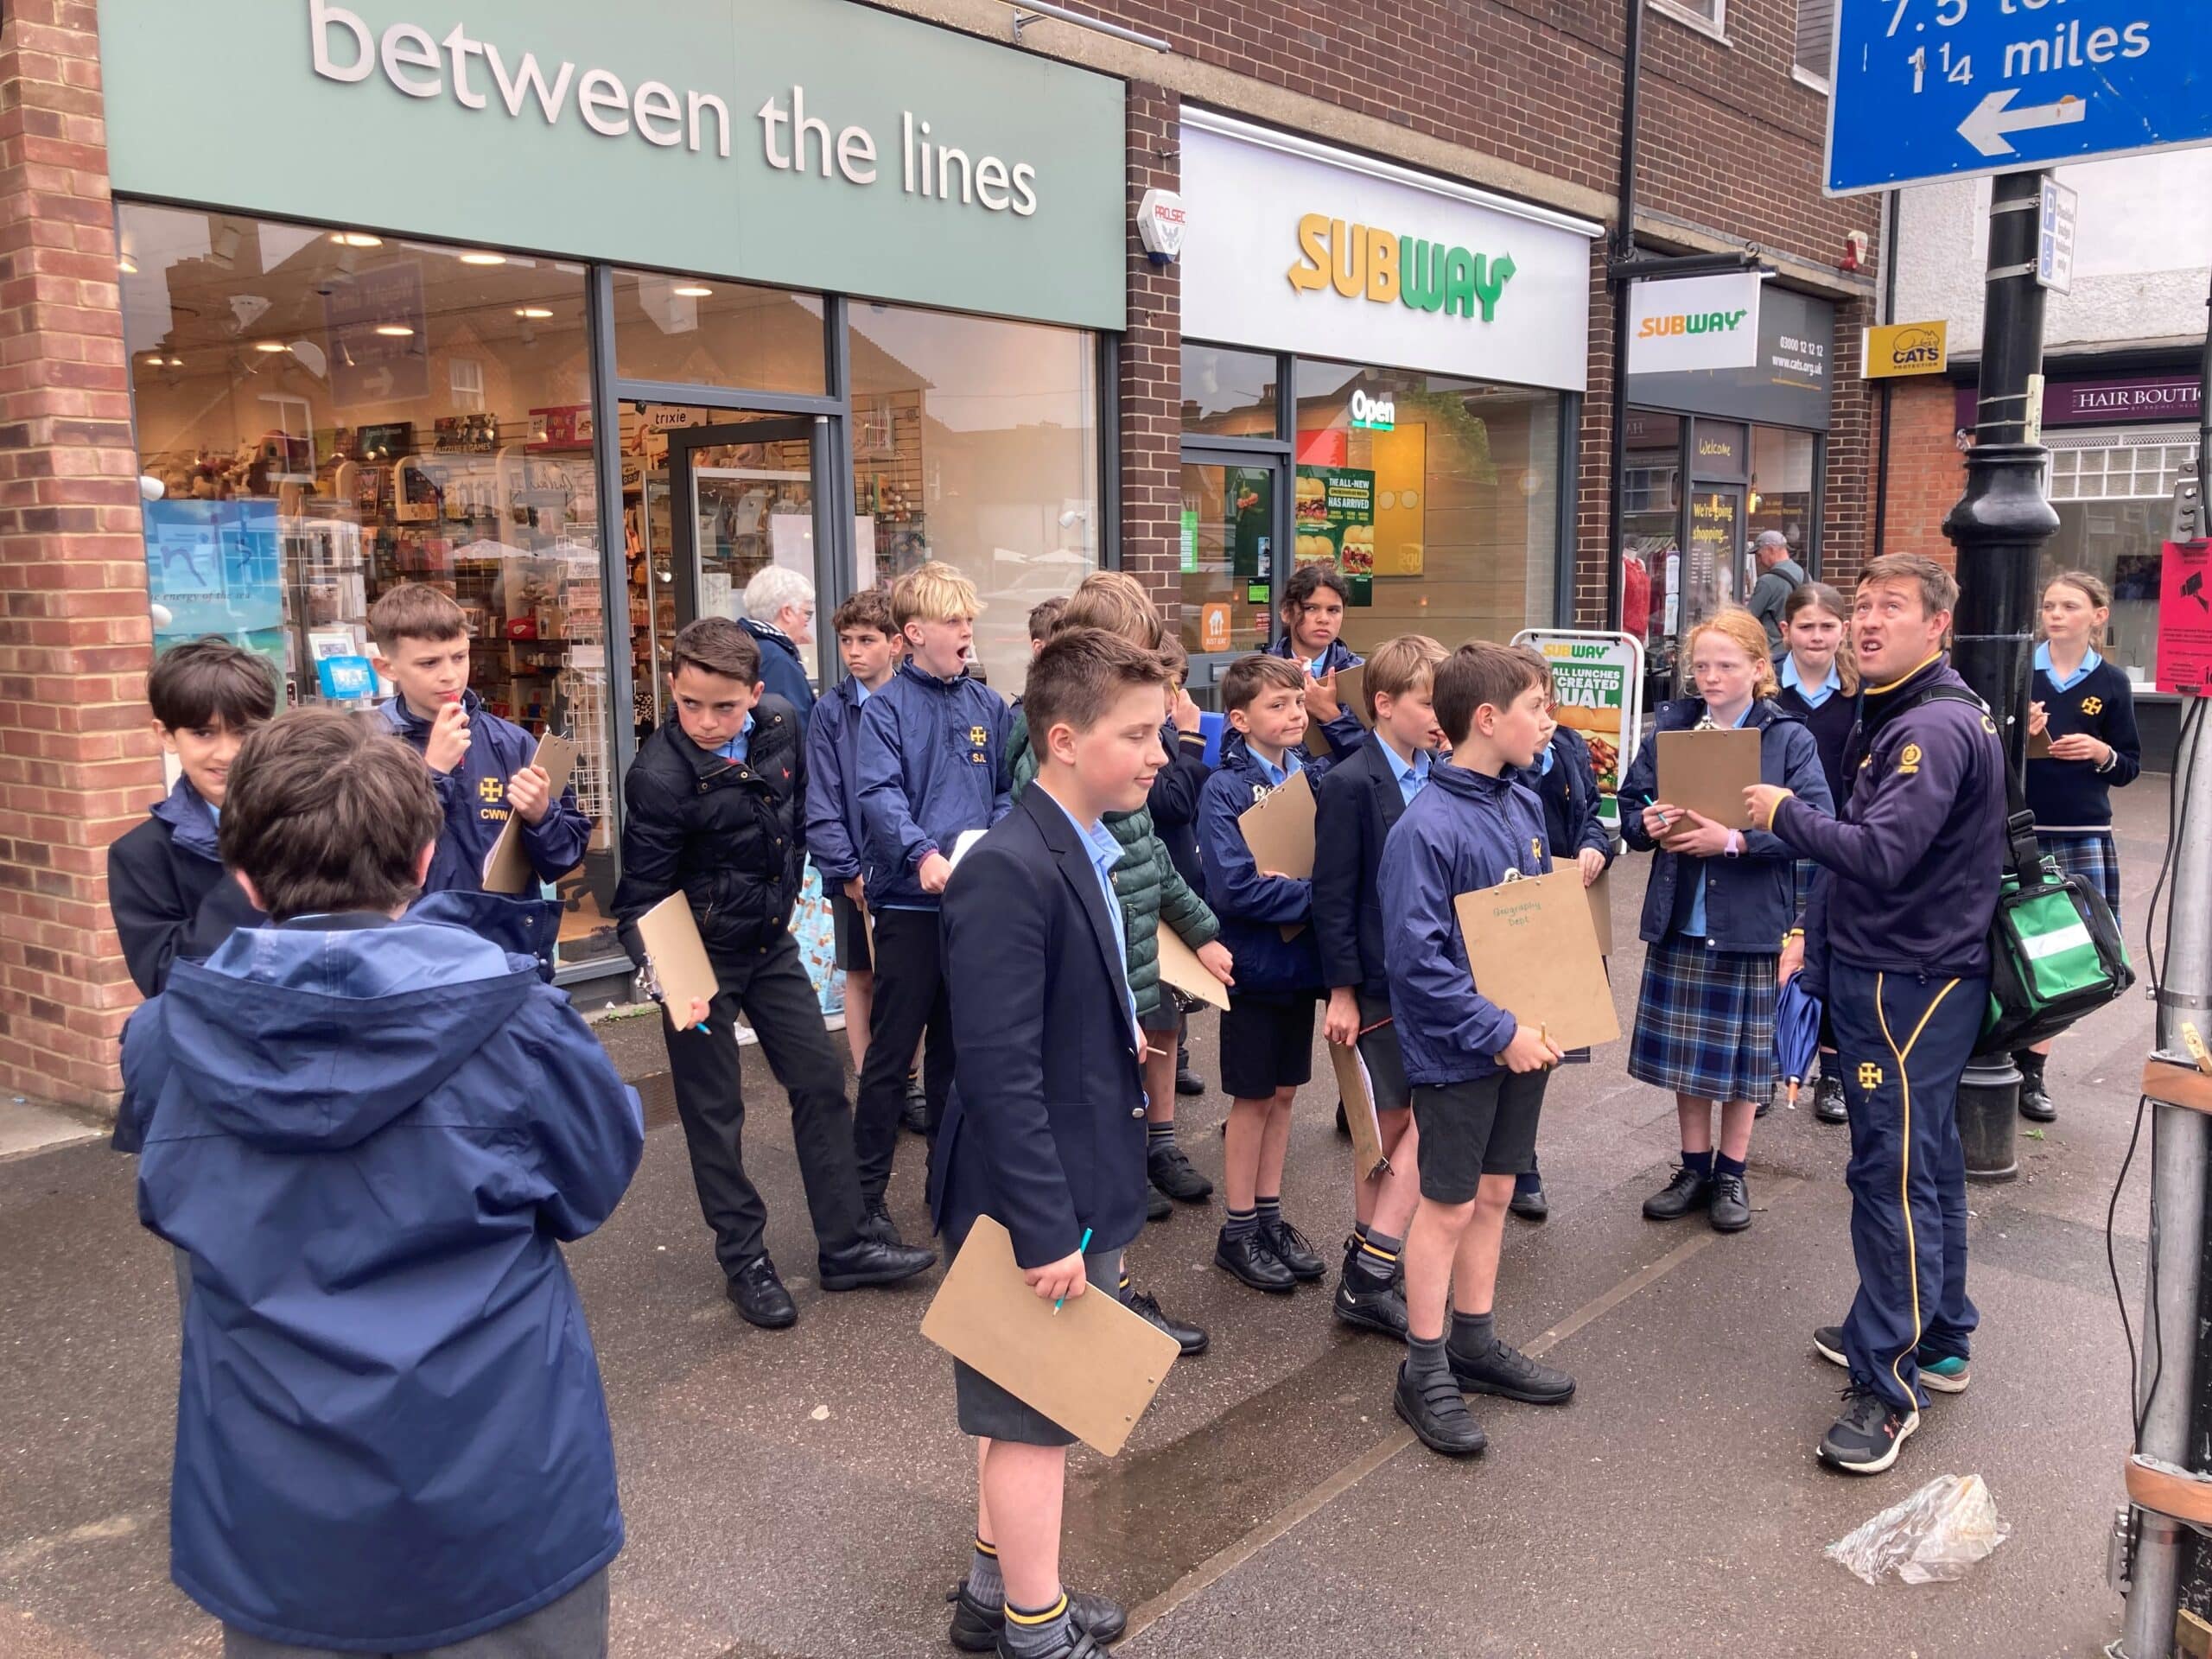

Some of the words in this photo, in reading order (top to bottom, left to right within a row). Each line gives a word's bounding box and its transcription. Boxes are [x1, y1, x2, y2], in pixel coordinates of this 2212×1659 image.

[1881, 0, 1968, 37] 7.5
[2003, 19, 2150, 79] miles
[307, 0, 731, 158] between
[757, 85, 878, 185] the
[903, 111, 1038, 217] lines
[1287, 212, 1517, 323] SUBWAY
[1637, 308, 1748, 340] SUBWAY
[1780, 335, 1799, 352] 03000
[1800, 340, 1807, 353] 12
[1808, 342, 1815, 355] 12
[1816, 344, 1823, 357] 12
[1892, 347, 1939, 364] CATS
[2080, 391, 2131, 408] HAIR
[2135, 387, 2201, 404] BOUTI
[655, 408, 687, 425] trixie
[1351, 389, 1395, 429] Open
[1699, 437, 1732, 457] Welcome
[1329, 477, 1339, 487] THE
[1339, 478, 1370, 489] ALL-NEW
[1328, 496, 1342, 508] HAS
[1342, 497, 1370, 510] ARRIVED
[202, 591, 213, 602] of
[1542, 643, 1610, 659] SUBWAY
[1552, 667, 1571, 677] ALL
[1572, 668, 1620, 679] LUNCHES
[1557, 676, 1619, 690] CREATED
[1554, 687, 1618, 709] UAL.
[480, 808, 508, 821] CWW
[1492, 900, 1541, 917] Geography
